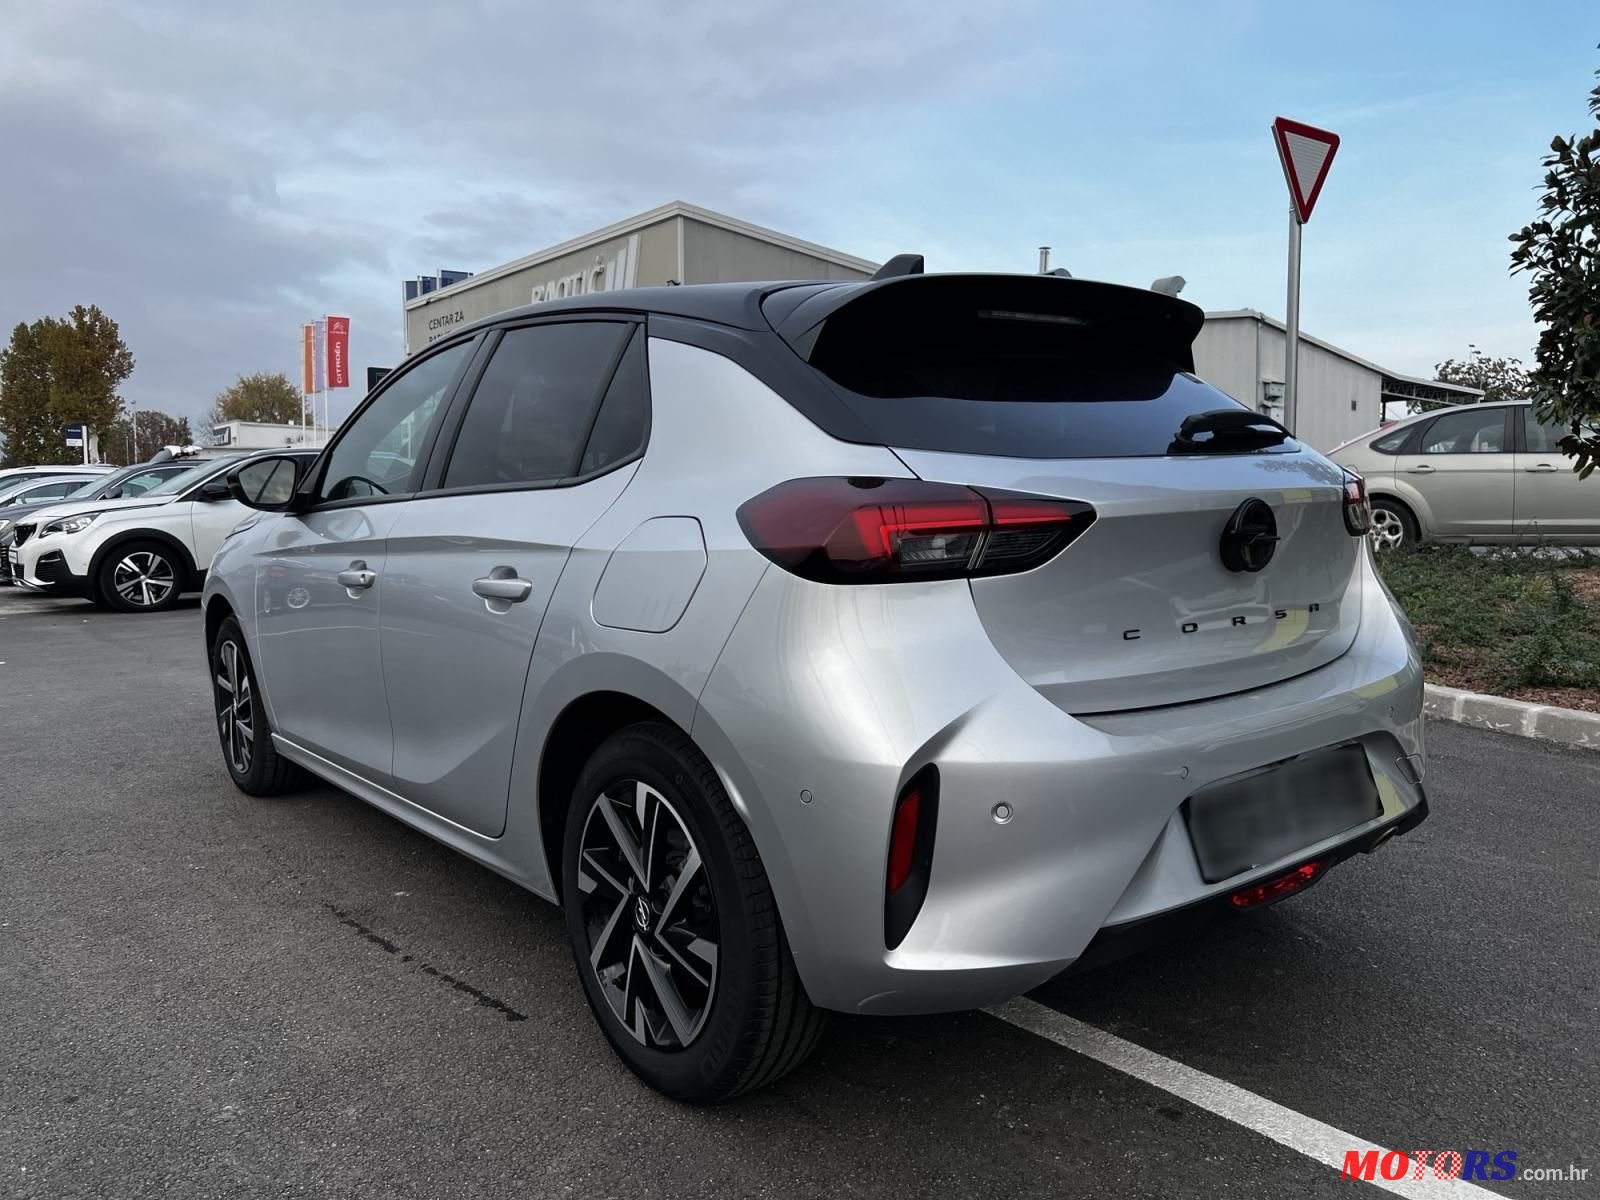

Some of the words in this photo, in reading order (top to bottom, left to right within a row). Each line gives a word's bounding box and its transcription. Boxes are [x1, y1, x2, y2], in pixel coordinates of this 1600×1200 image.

[428, 313, 453, 331] CENTAR
[454, 310, 465, 323] ZA
[1123, 602, 1319, 641] CORSA
